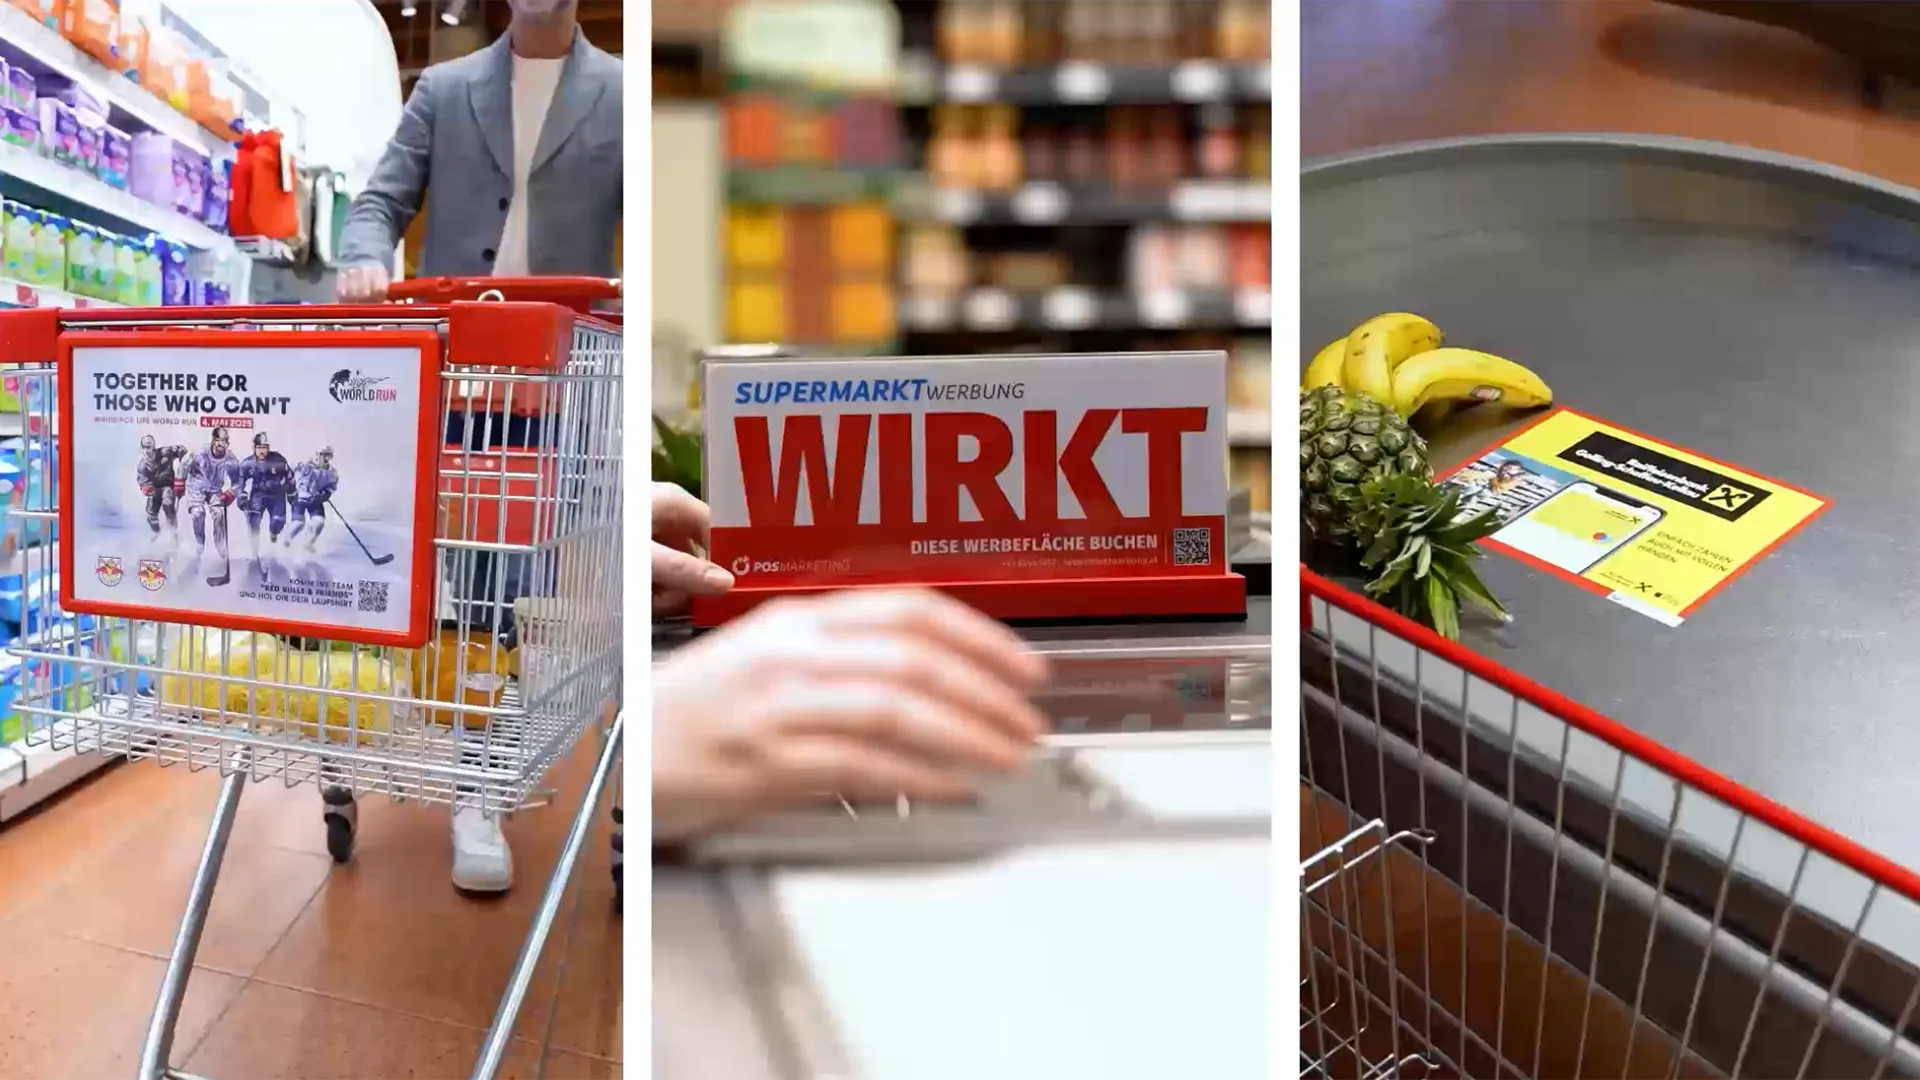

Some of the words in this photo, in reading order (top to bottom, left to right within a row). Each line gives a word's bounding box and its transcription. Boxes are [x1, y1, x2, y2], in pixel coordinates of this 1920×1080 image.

[93, 373, 199, 391] TOGETHER
[206, 374, 248, 392] FOR
[735, 379, 1025, 404] SUPERMARKTWERBUNG
[93, 394, 157, 411] THOSE
[164, 395, 217, 413] WHO
[224, 396, 291, 415] CAN'T
[136, 417, 150, 425] LIFE
[152, 418, 180, 426] WORLD
[182, 418, 198, 427] RUN
[202, 418, 210, 427] 4.
[212, 418, 228, 427] MAI
[229, 419, 253, 428] 2025
[734, 407, 1209, 528] WIRKT
[910, 538, 959, 555] DIESE
[962, 533, 1086, 554] WERBEFLÄCHE
[1089, 534, 1158, 550] BUCHEN
[753, 558, 851, 573] POSMARKETING
[289, 578, 314, 588] KOMM
[332, 581, 353, 590] TEAM
[239, 590, 256, 599] UND
[258, 592, 273, 600] HOL
[275, 593, 289, 602] DIR
[311, 597, 353, 608] LAUFSHIRT
